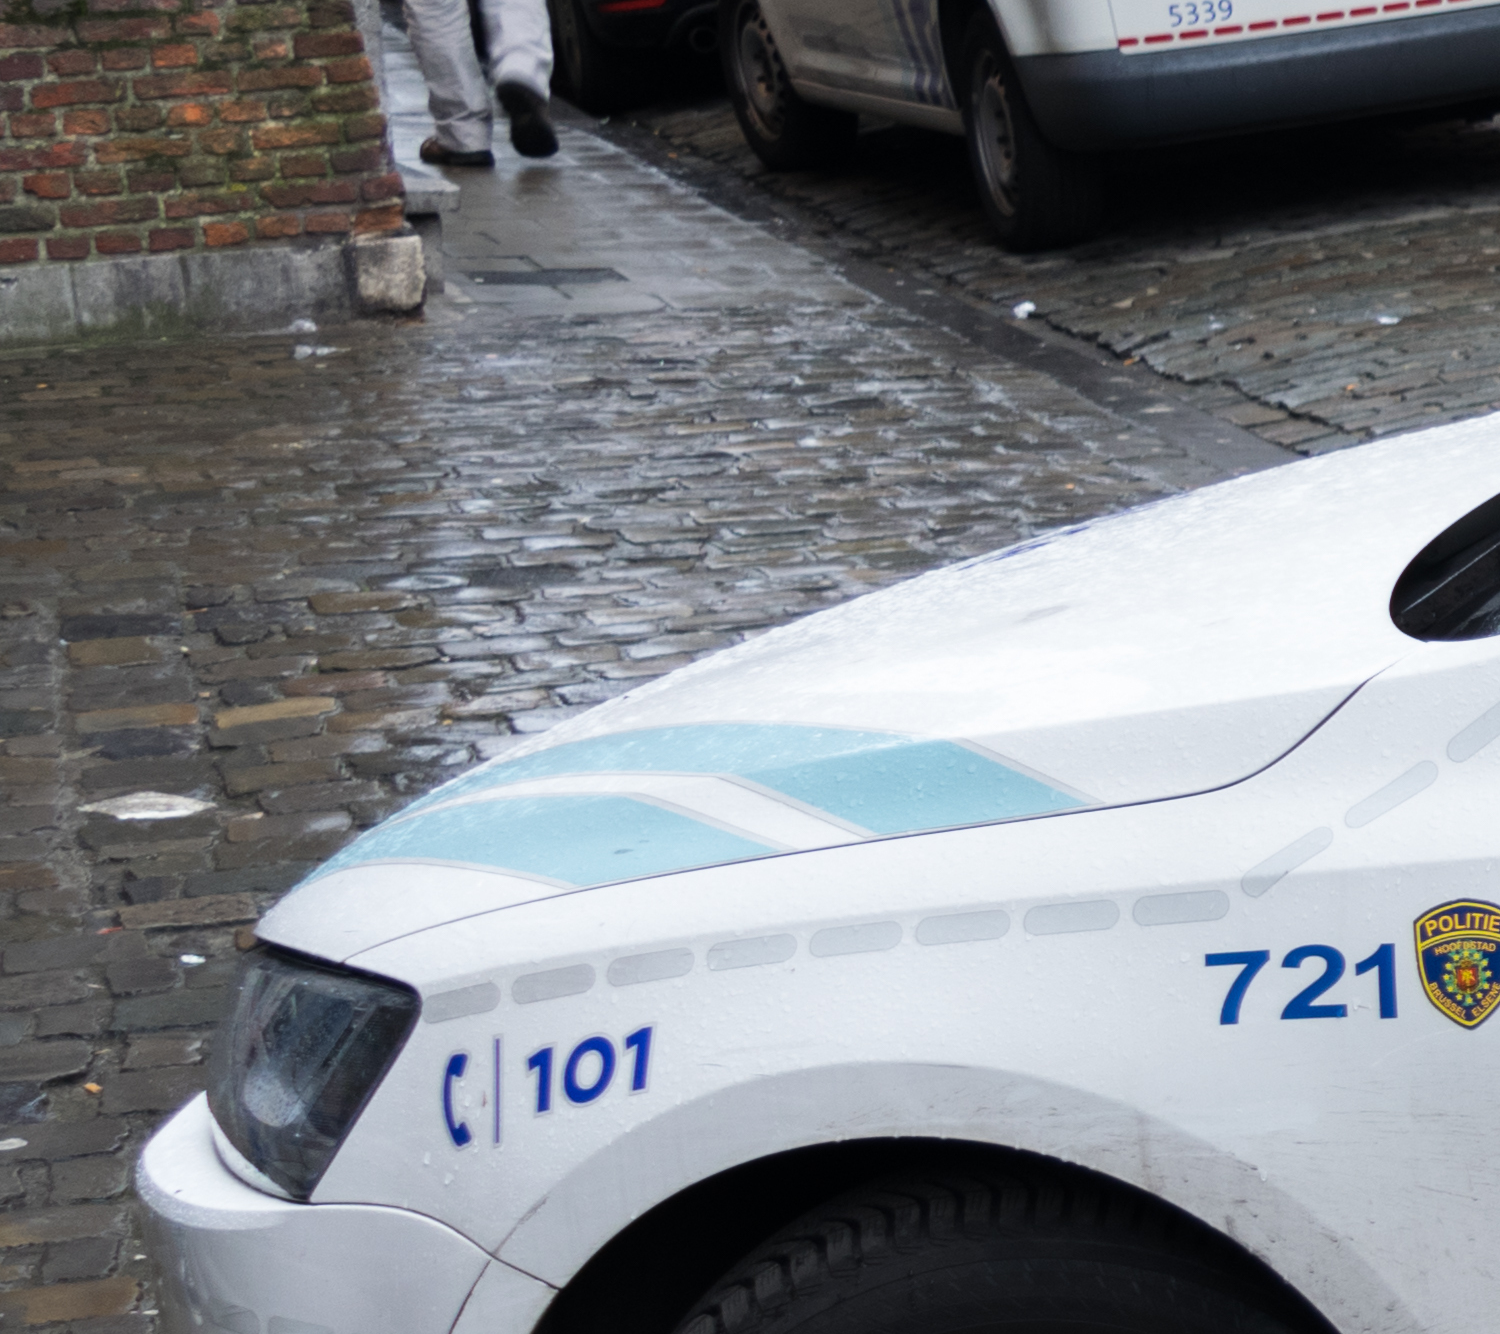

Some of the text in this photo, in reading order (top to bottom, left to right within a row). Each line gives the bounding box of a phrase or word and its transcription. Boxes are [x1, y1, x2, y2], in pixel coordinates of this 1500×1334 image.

[1434, 940, 1496, 955] HOOFDSTAD
[1204, 942, 1398, 1026] 721
[1428, 981, 1467, 1020] BRUSSEL
[528, 1026, 653, 1113] 101
